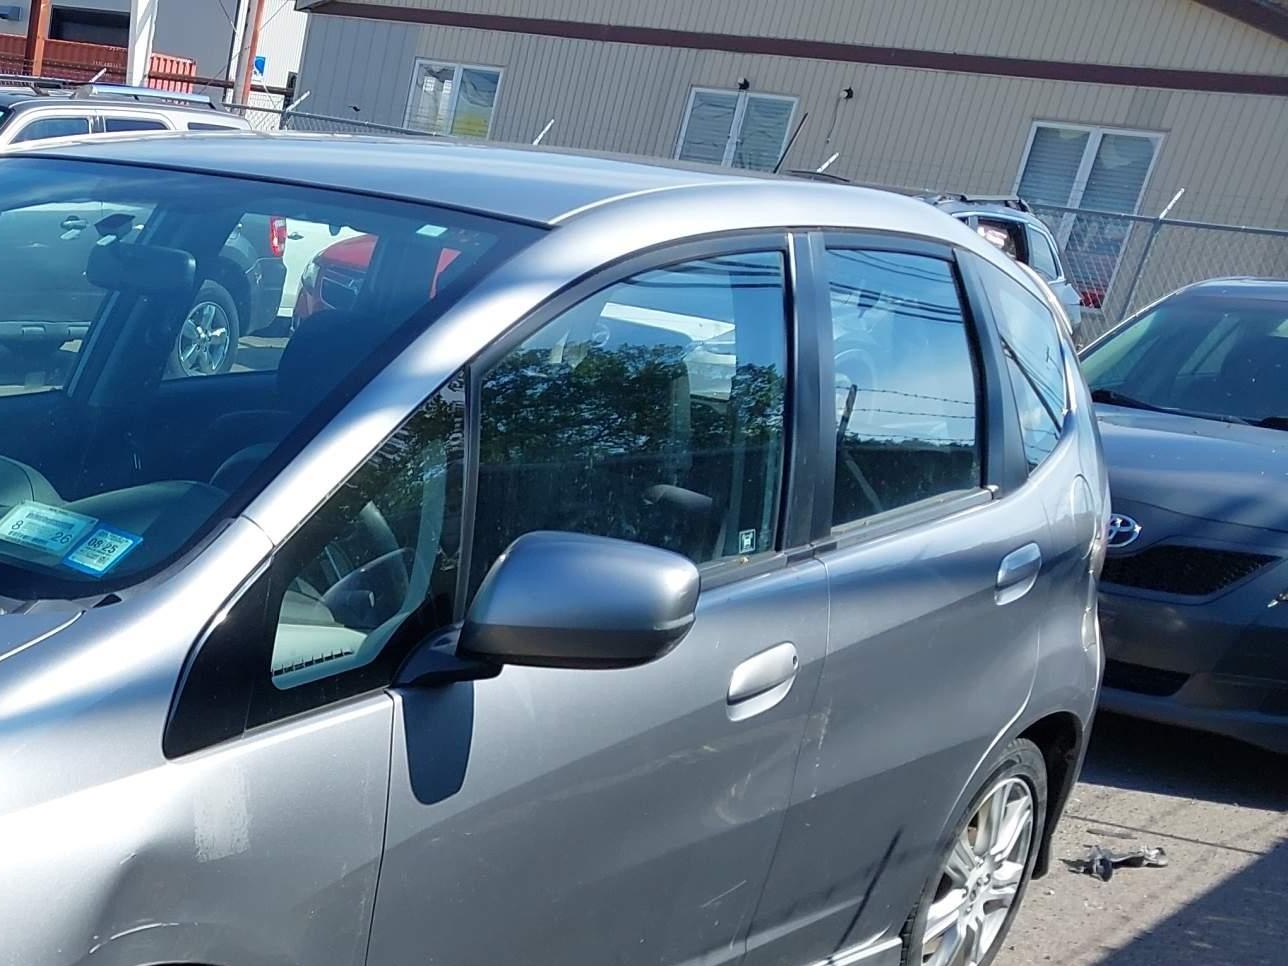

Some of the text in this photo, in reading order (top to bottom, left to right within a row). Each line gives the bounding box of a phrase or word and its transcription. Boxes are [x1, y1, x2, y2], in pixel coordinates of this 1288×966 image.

[11, 519, 24, 530] 8
[50, 531, 73, 545] 26
[87, 537, 104, 549] 08
